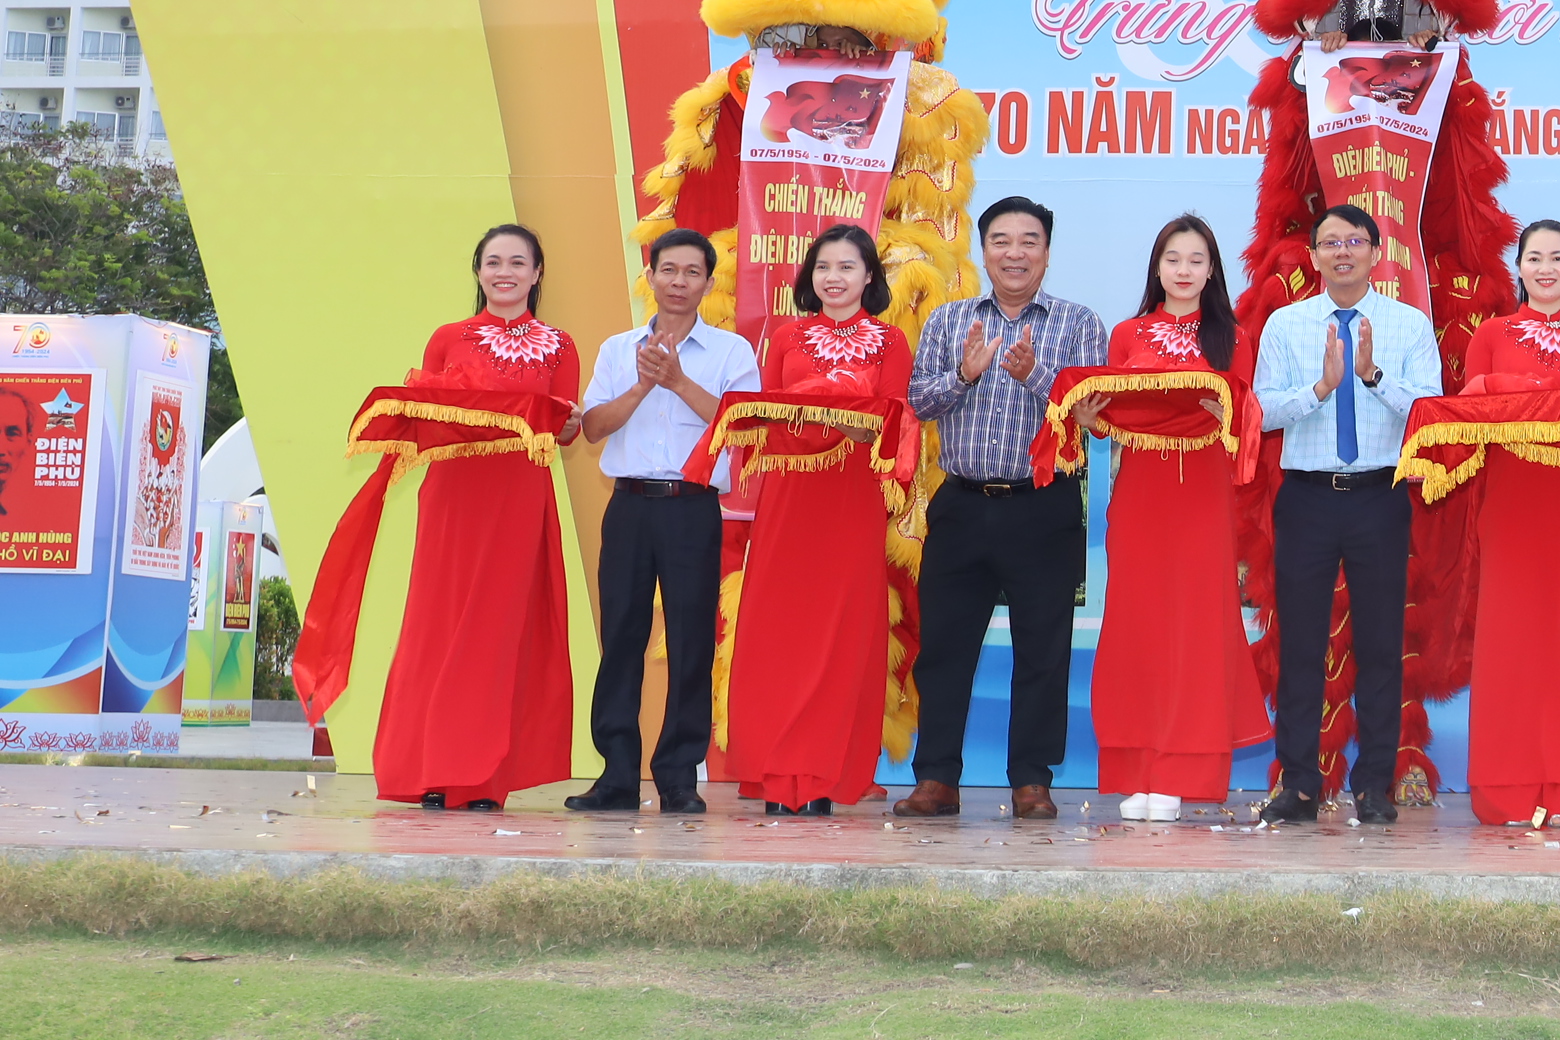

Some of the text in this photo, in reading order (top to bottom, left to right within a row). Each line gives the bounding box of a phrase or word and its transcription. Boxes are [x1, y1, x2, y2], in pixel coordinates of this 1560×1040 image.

[1047, 76, 1173, 155] NĂM
[750, 147, 811, 160] 07/5/1954
[822, 152, 887, 169] 07/5/2024
[1332, 144, 1363, 182] ĐIỆN
[1363, 140, 1388, 173] BIÊN
[1386, 148, 1409, 183] PHỦ
[764, 174, 868, 219] CHIẾN THẮNG
[1376, 185, 1404, 226] THNG
[750, 228, 817, 271] ĐIỆN BIÊ
[773, 280, 808, 317] LỪN
[35, 436, 84, 452] ĐIỆN
[35, 451, 82, 466] BIÊN
[35, 464, 81, 480] PHỦ
[0, 529, 72, 544] C ANH HÙNG
[22, 546, 39, 561] VĨ
[42, 549, 71, 564] ĐẠI
